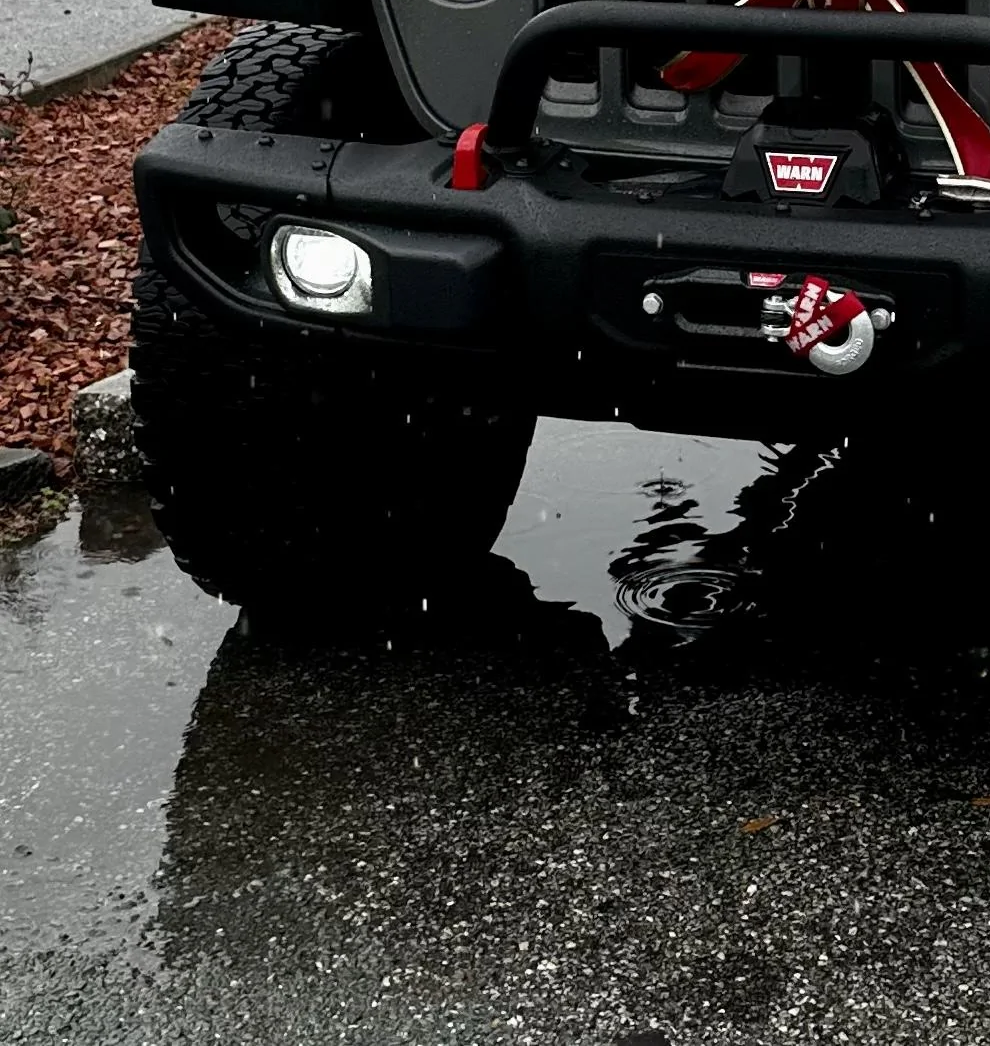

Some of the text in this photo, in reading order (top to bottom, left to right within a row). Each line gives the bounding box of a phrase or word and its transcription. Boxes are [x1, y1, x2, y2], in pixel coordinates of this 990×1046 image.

[776, 164, 823, 181] WARN
[794, 282, 822, 328] ARN
[786, 315, 834, 353] WARN
